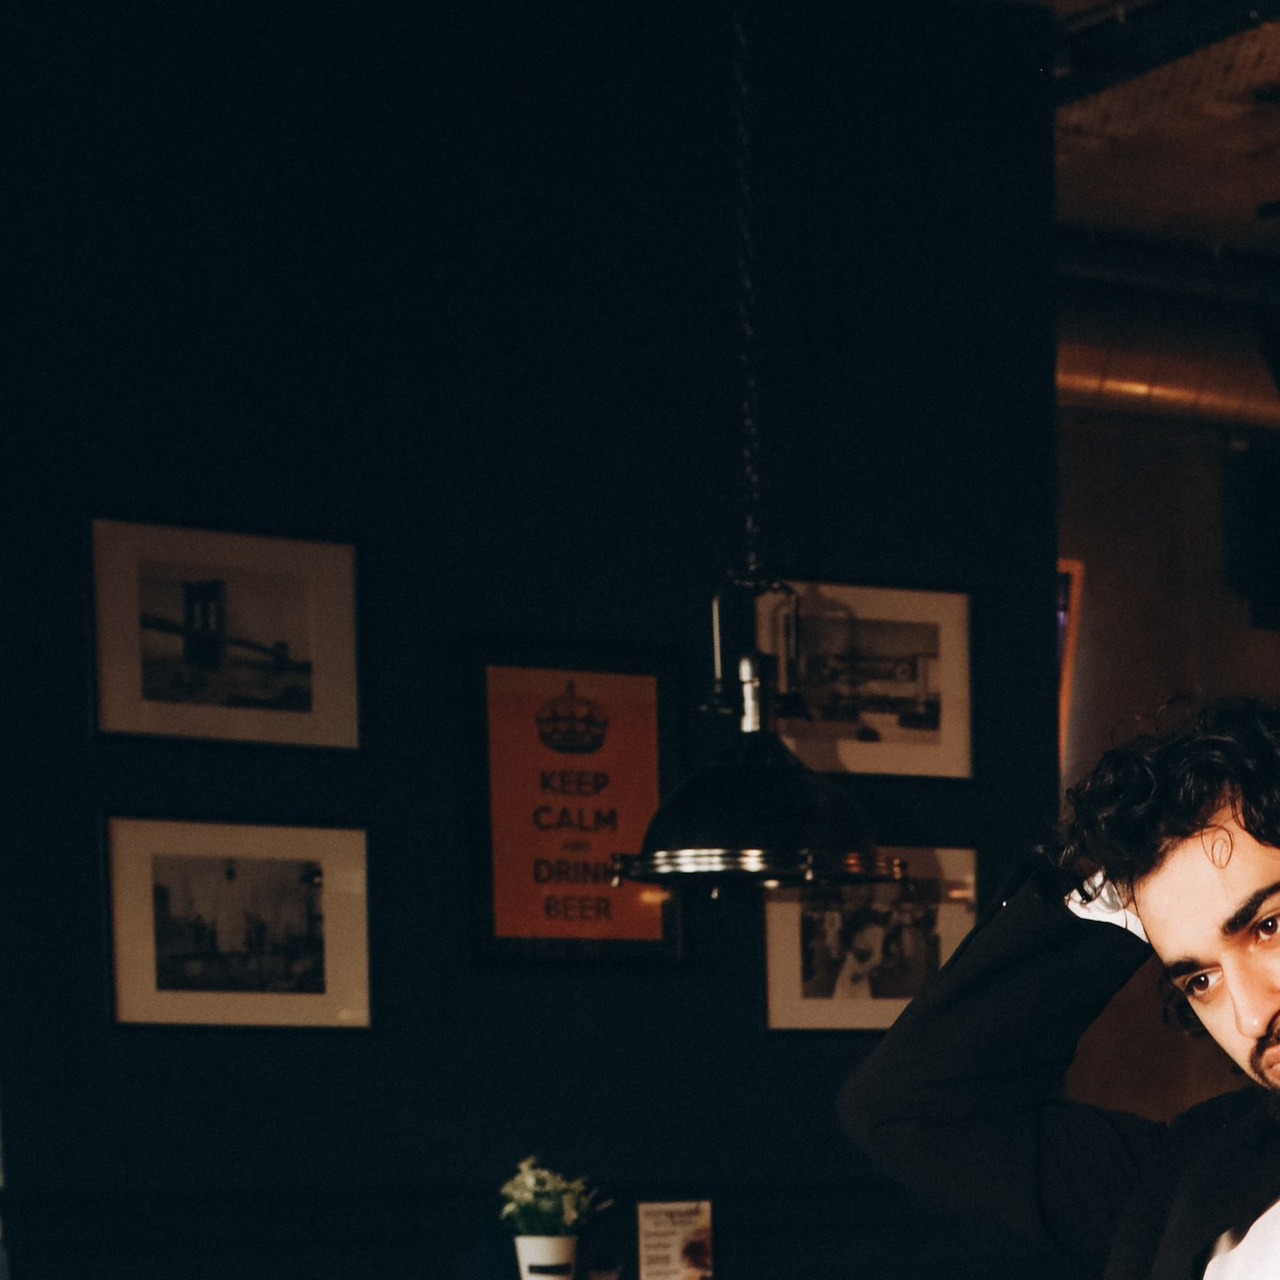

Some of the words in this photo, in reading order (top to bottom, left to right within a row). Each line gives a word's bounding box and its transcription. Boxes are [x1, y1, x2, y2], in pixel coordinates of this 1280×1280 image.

[542, 770, 610, 795] KEEP
[533, 806, 617, 832] CALM
[544, 895, 612, 920] BEER
